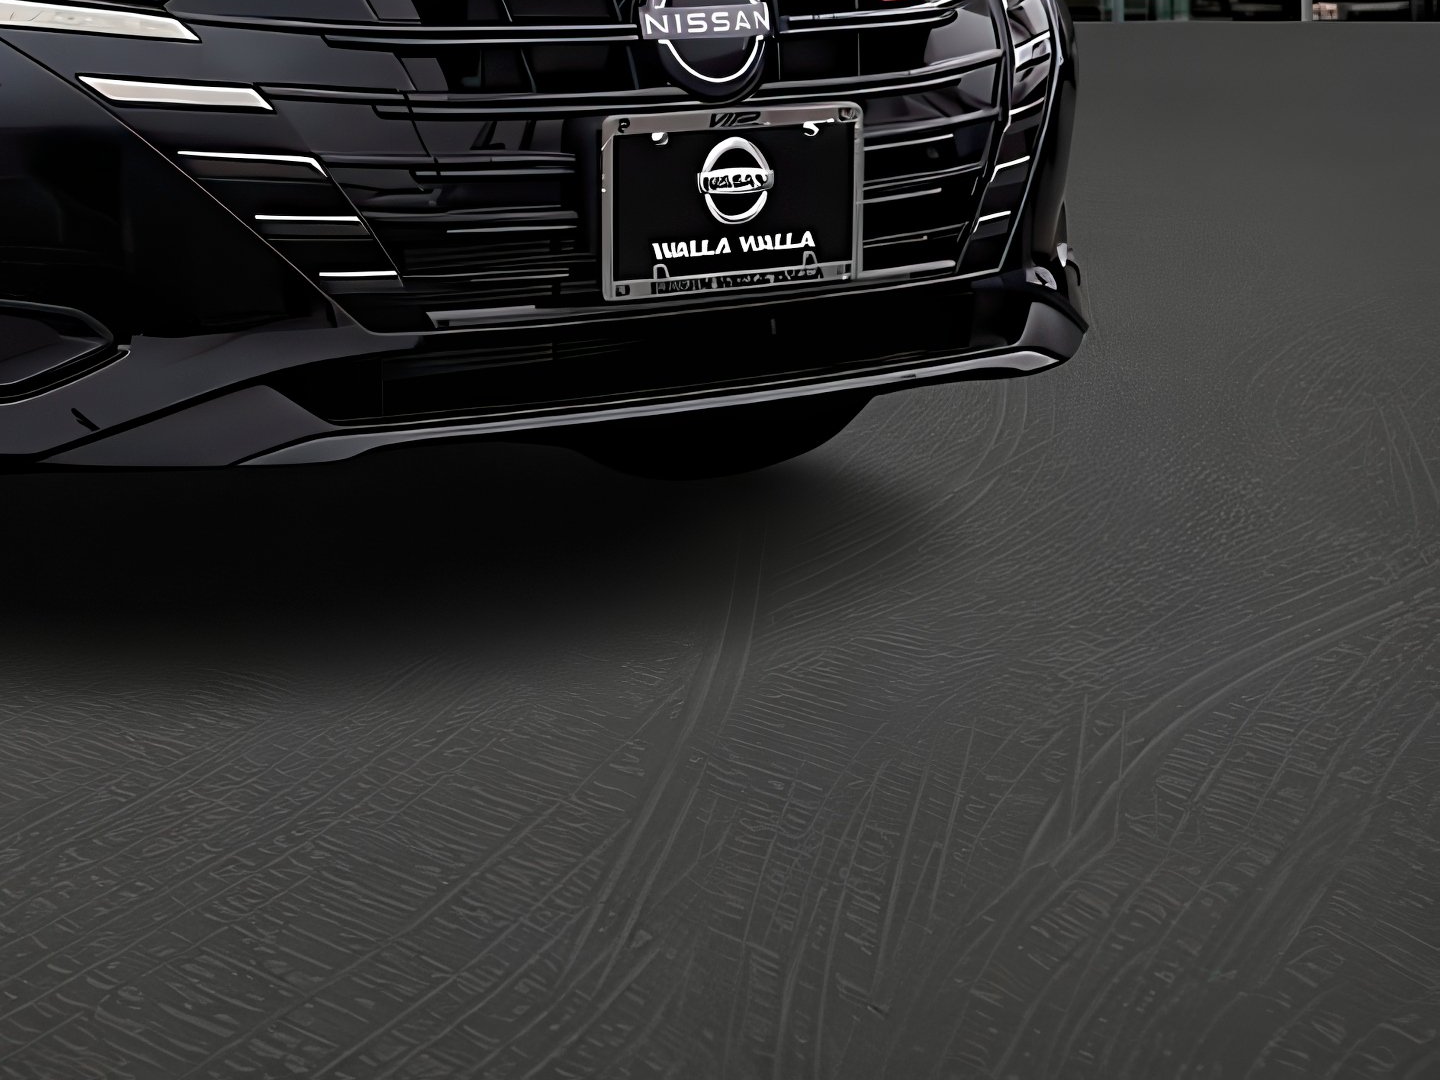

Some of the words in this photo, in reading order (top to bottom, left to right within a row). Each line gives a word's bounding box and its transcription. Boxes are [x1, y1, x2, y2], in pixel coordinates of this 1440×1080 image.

[644, 8, 771, 35] NISSAN
[652, 236, 732, 260] WALLA
[738, 230, 816, 253] WALLA
